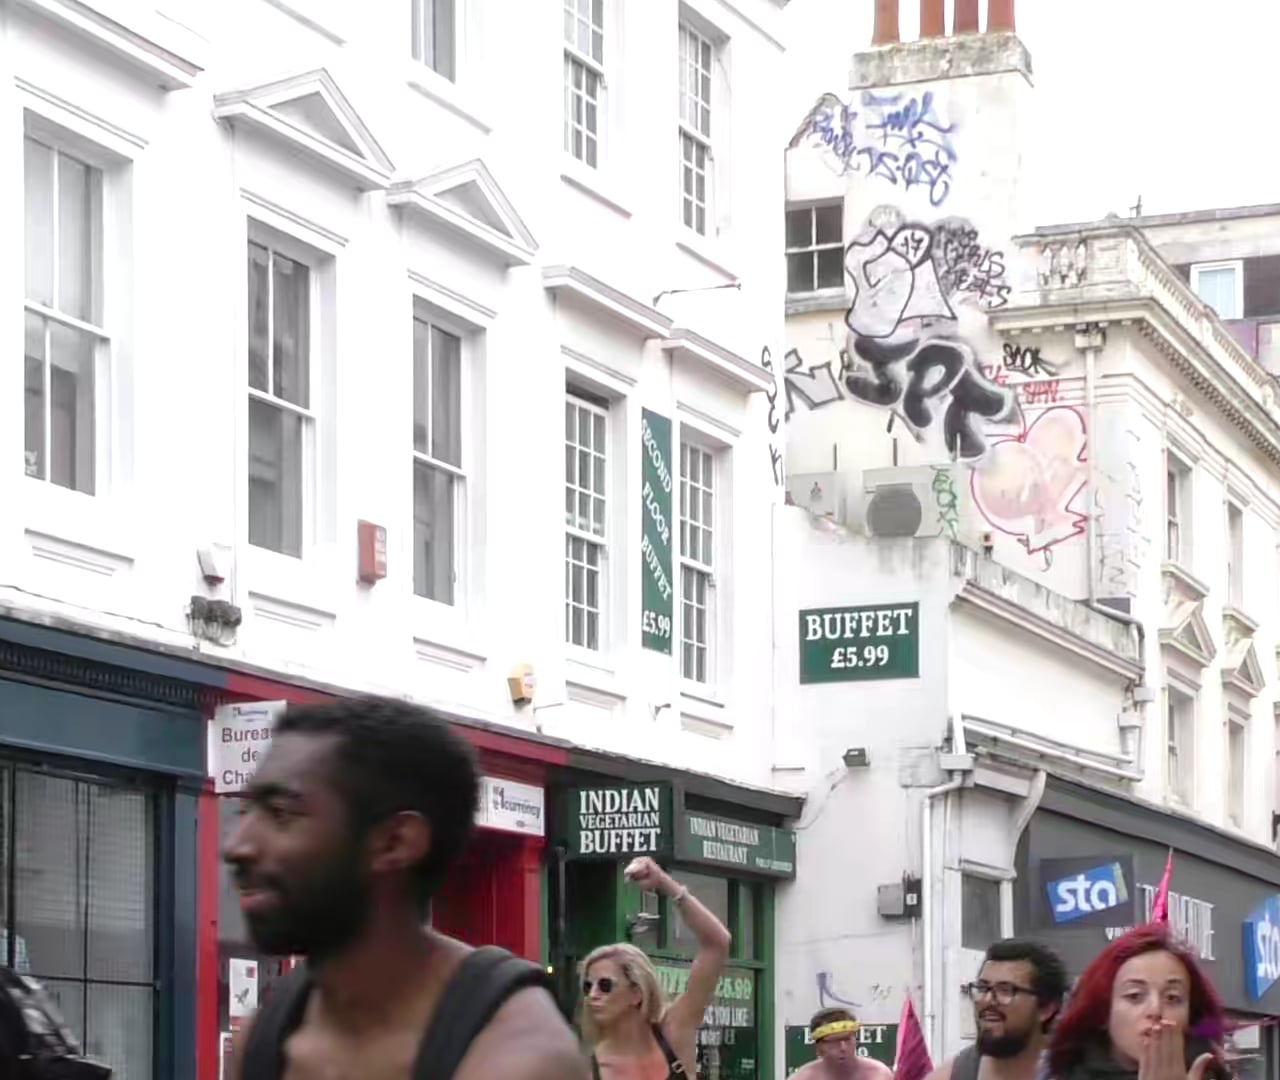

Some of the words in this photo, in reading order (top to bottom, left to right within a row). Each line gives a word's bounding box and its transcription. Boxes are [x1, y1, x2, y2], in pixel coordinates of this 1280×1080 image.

[641, 418, 672, 493] SECOND
[642, 481, 670, 546] FLOOR
[641, 534, 672, 601] BUFFET
[642, 609, 671, 639] £5.99
[805, 608, 913, 641] BUFFET
[830, 644, 890, 669] £5.99
[221, 726, 272, 743] Burea
[579, 787, 661, 814] INDIAN
[579, 811, 661, 830] VEGETARIAN
[579, 827, 662, 854] BUFFET
[1056, 872, 1117, 914] sta
